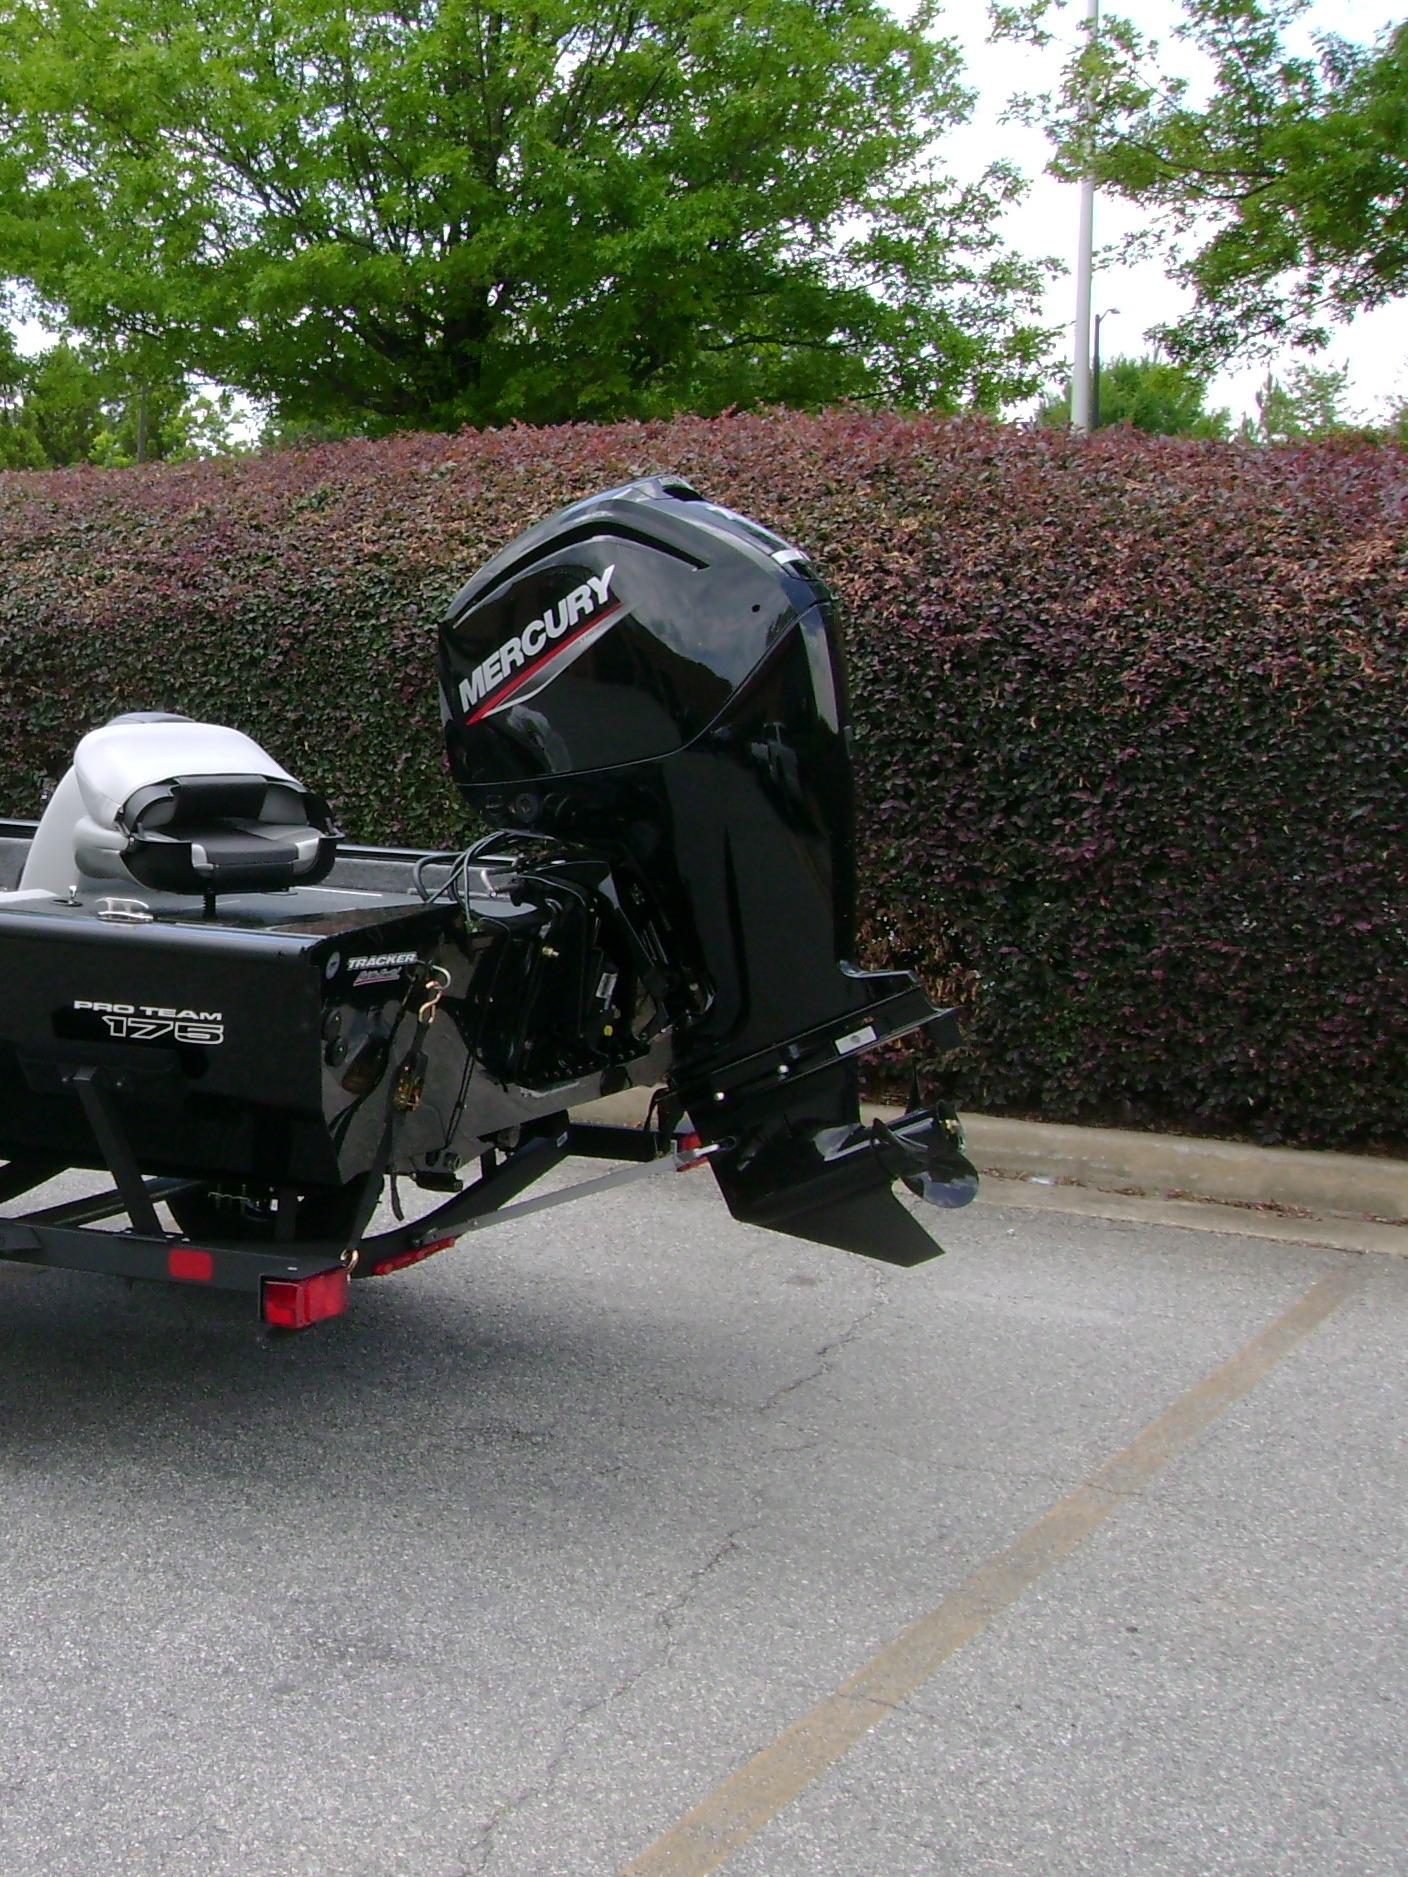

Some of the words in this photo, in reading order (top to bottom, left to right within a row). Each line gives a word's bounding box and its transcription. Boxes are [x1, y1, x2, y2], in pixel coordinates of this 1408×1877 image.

[459, 564, 615, 713] MERCURY
[346, 952, 418, 971] TRACKER
[73, 1000, 135, 1014] PRO
[139, 1006, 223, 1021] TEAM
[102, 1015, 224, 1045] 175
